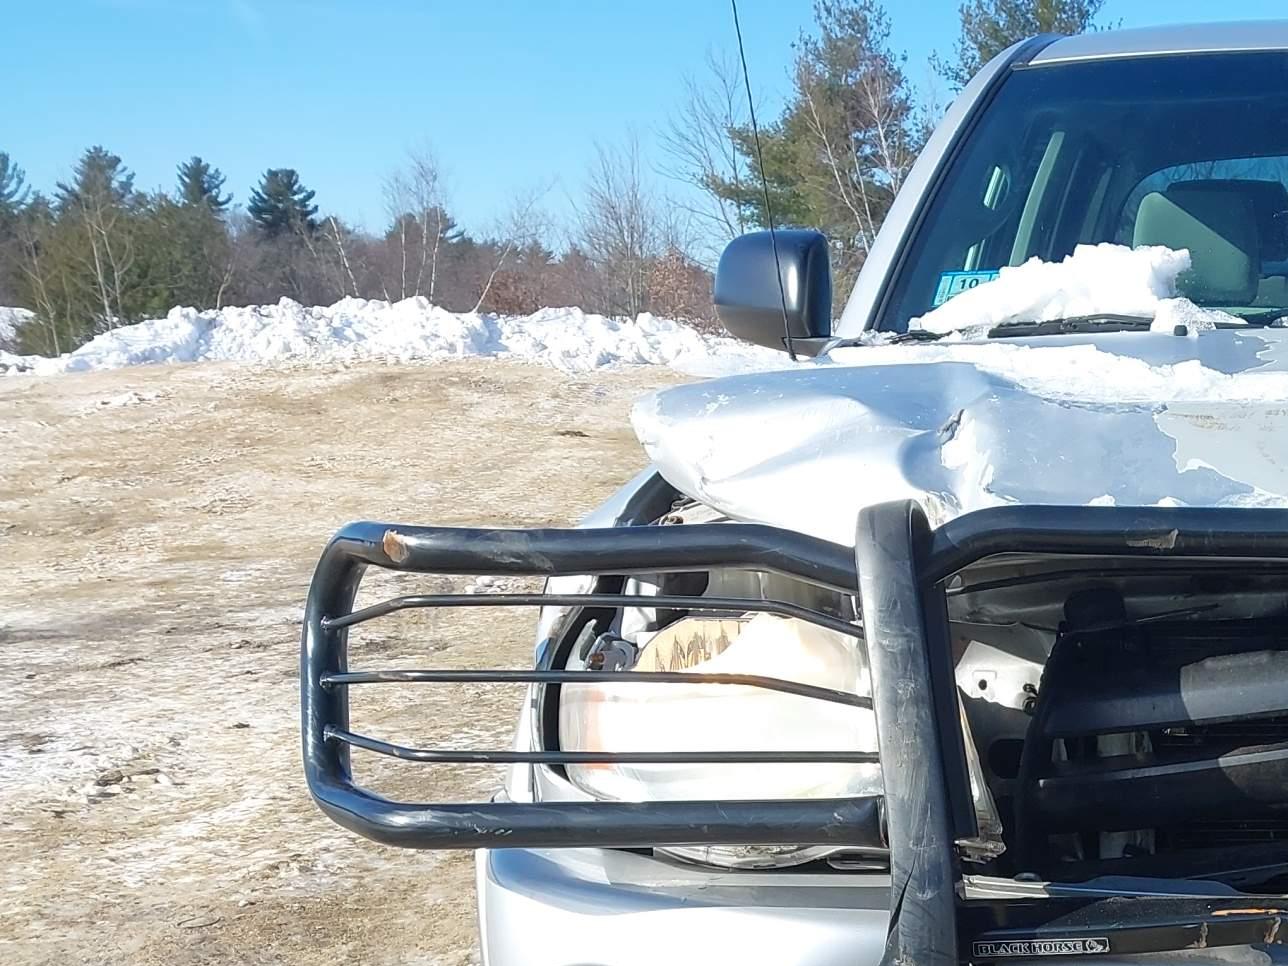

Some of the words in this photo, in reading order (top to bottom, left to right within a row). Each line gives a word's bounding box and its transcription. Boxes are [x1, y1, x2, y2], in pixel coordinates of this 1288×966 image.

[960, 278, 979, 290] 10
[977, 943, 1031, 955] BLACK
[1031, 941, 1083, 954] HORSE
